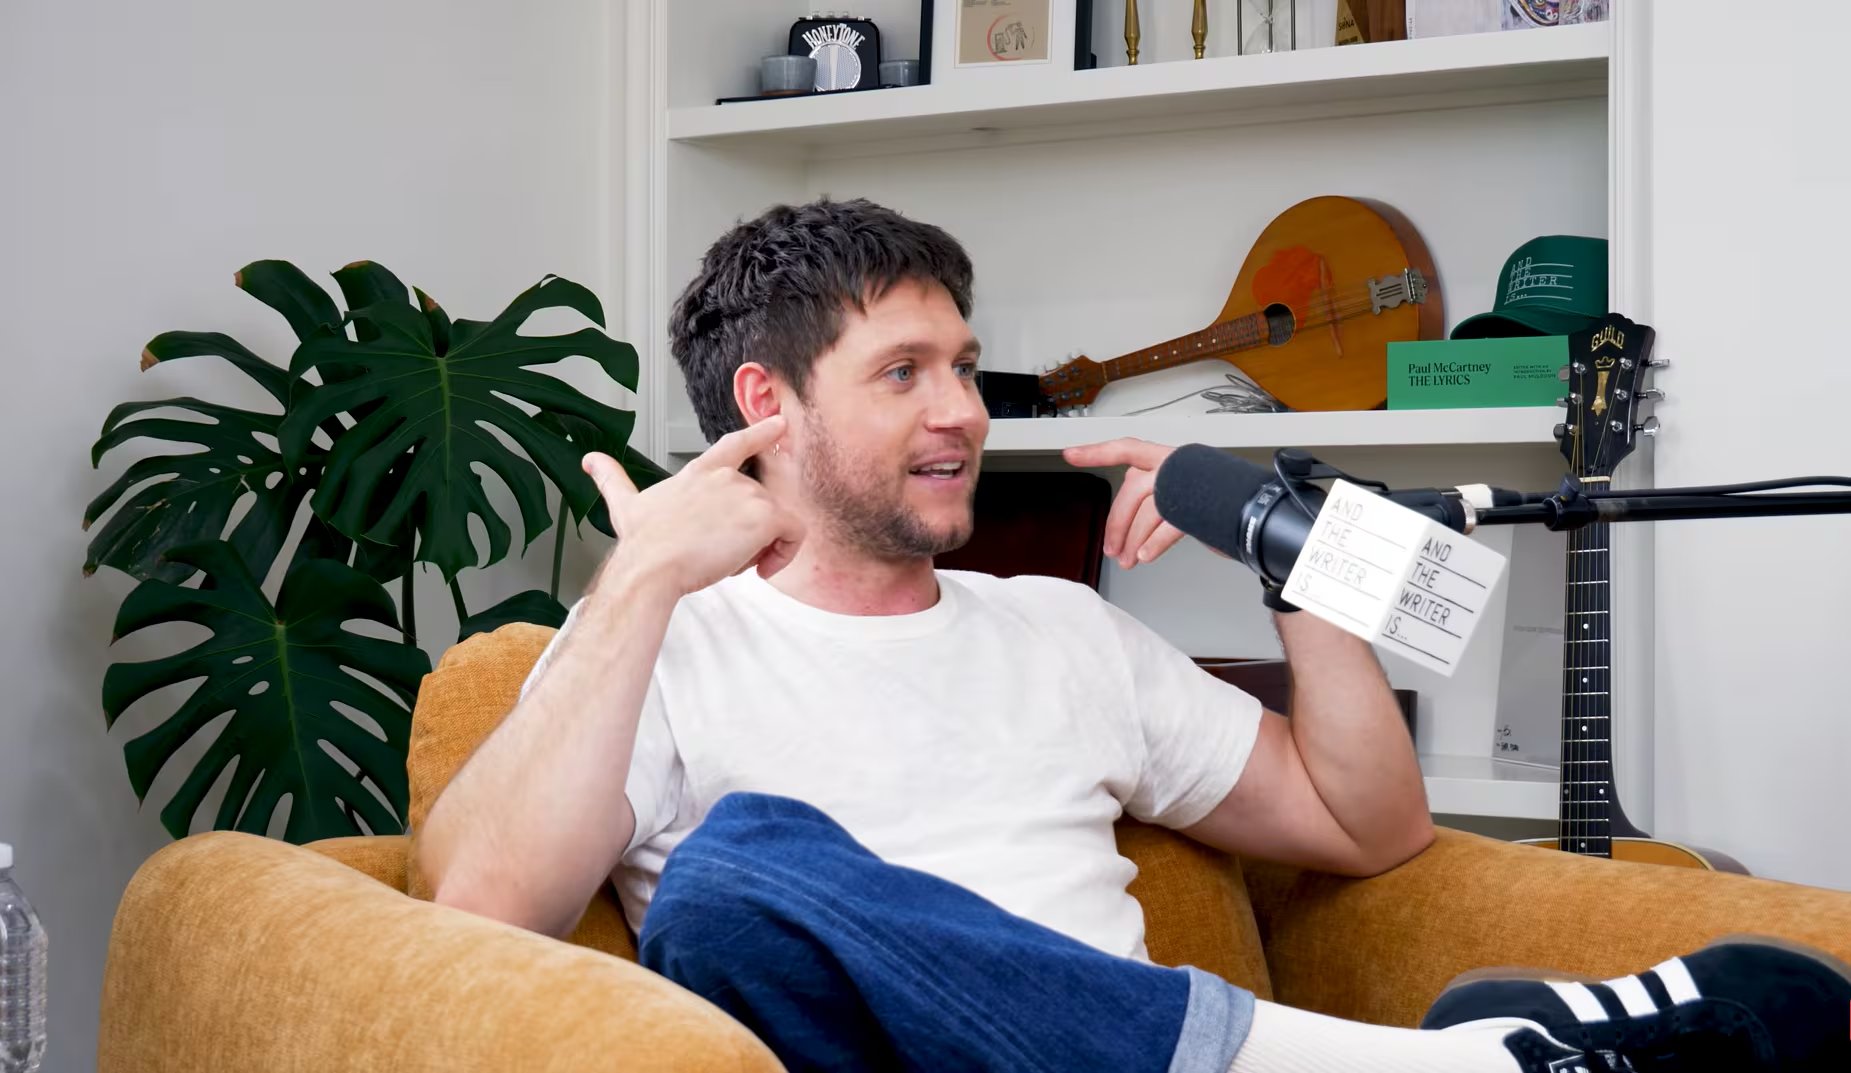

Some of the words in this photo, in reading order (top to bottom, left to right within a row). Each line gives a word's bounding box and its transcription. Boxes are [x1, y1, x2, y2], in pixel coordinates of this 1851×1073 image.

[802, 23, 866, 50] HONEYTONE
[1511, 257, 1532, 275] AND
[1507, 276, 1557, 293] WRITER
[1591, 324, 1625, 349] GUILD
[1408, 363, 1431, 374] Paul
[1434, 361, 1492, 375] McCartney
[1408, 375, 1431, 387] THE
[1434, 374, 1471, 386] LYRICS
[1330, 496, 1364, 522] AND
[1320, 520, 1353, 548] THE
[1421, 537, 1452, 563] AND
[1308, 546, 1368, 585] WRITER
[1411, 562, 1440, 589] THE
[1400, 589, 1451, 626] WRITER
